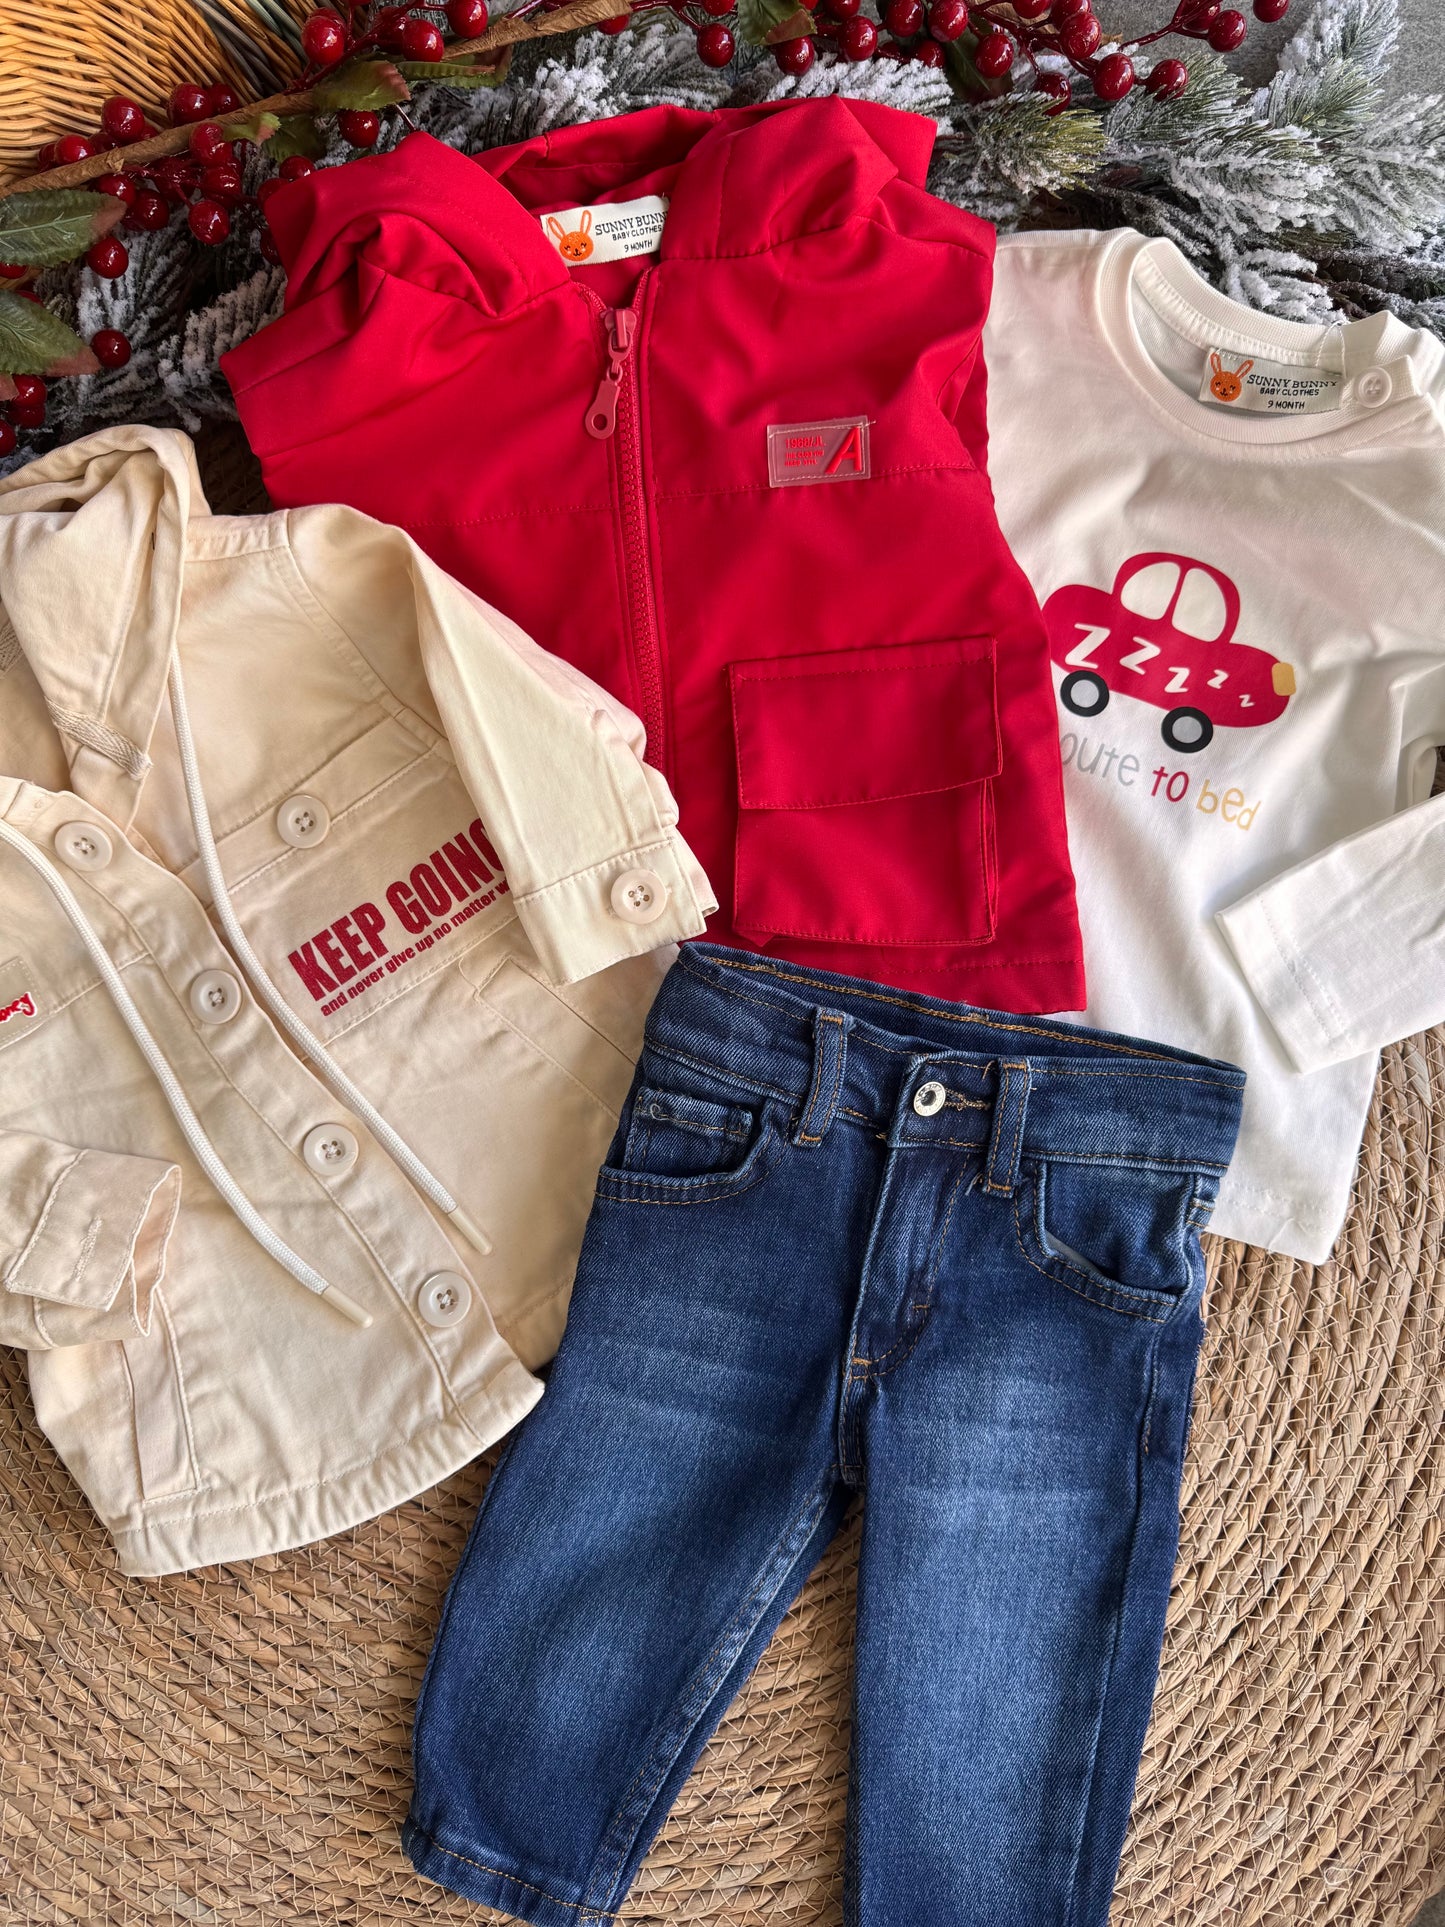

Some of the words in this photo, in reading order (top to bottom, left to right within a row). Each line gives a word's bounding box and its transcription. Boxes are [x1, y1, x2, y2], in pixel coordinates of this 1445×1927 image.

[595, 218, 634, 236] SUNNY
[637, 211, 668, 228] BUNN
[612, 231, 630, 241] BABY
[632, 224, 662, 237] CLOTHES
[624, 244, 630, 253] 9
[630, 240, 653, 252] MONTH
[1247, 374, 1292, 388] SUNNY
[1292, 380, 1338, 389] BUNNY
[1260, 387, 1281, 395] BABY
[1281, 388, 1319, 396] CLOTHES
[1267, 400, 1274, 409] 9
[1275, 401, 1305, 409] MONTH
[825, 426, 862, 474] A
[1151, 766, 1189, 802] to
[1196, 779, 1261, 831] bed
[287, 902, 389, 1001] KEEP
[320, 992, 349, 1016] and
[347, 966, 385, 998] never
[386, 944, 416, 973] give
[415, 934, 435, 953] up
[433, 922, 451, 940] no
[450, 889, 497, 927] matter
